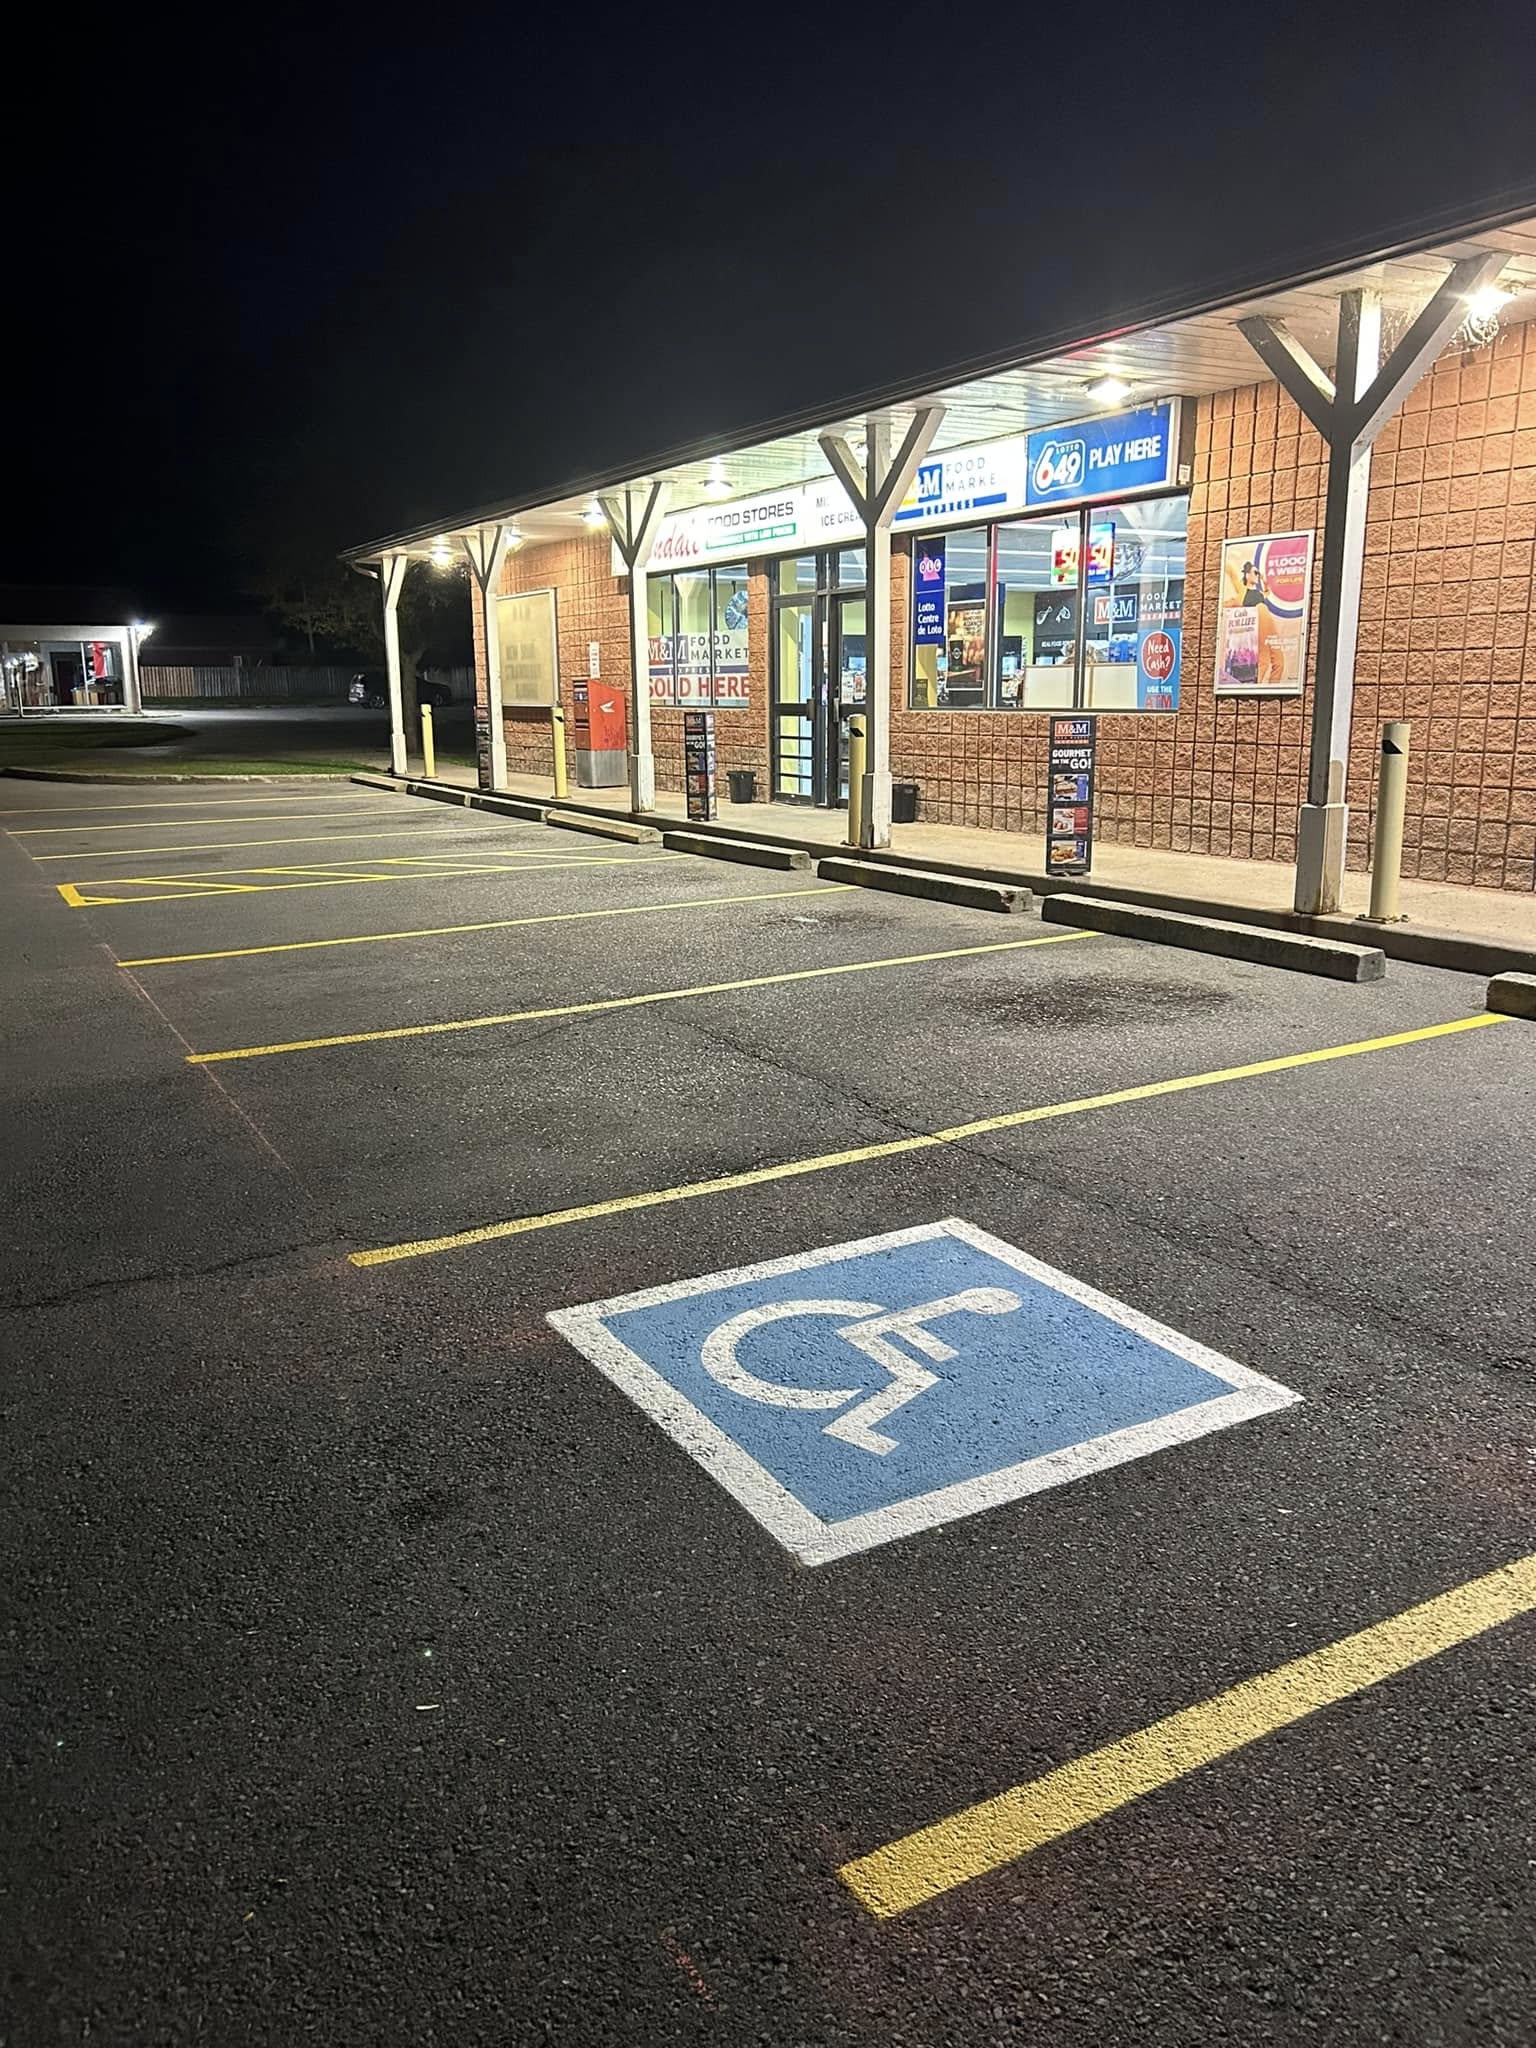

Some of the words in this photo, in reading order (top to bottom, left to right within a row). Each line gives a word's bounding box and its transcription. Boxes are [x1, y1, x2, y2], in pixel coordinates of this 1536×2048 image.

[1088, 443, 1122, 470] PLAY
[1124, 435, 1162, 462] HERE
[945, 456, 986, 475] FOOD
[743, 501, 794, 524] STORES
[820, 514, 835, 528] ICE
[918, 602, 935, 612] Lotto
[1098, 599, 1134, 622] M&M
[1140, 600, 1182, 612] MARKET
[917, 613, 939, 624] Centre
[917, 625, 926, 635] de
[927, 624, 943, 634] Loto
[690, 634, 731, 647] FOOD
[1147, 639, 1170, 654] Need
[690, 648, 749, 661] MARKET
[1146, 655, 1171, 672] Cash?
[649, 677, 691, 698] OLD
[698, 676, 750, 698] HERE
[1160, 685, 1173, 693] THE
[1145, 694, 1173, 709] ATM
[1057, 723, 1088, 735] M&M
[1052, 748, 1093, 758] GOURMET
[1070, 758, 1091, 769] GO!
